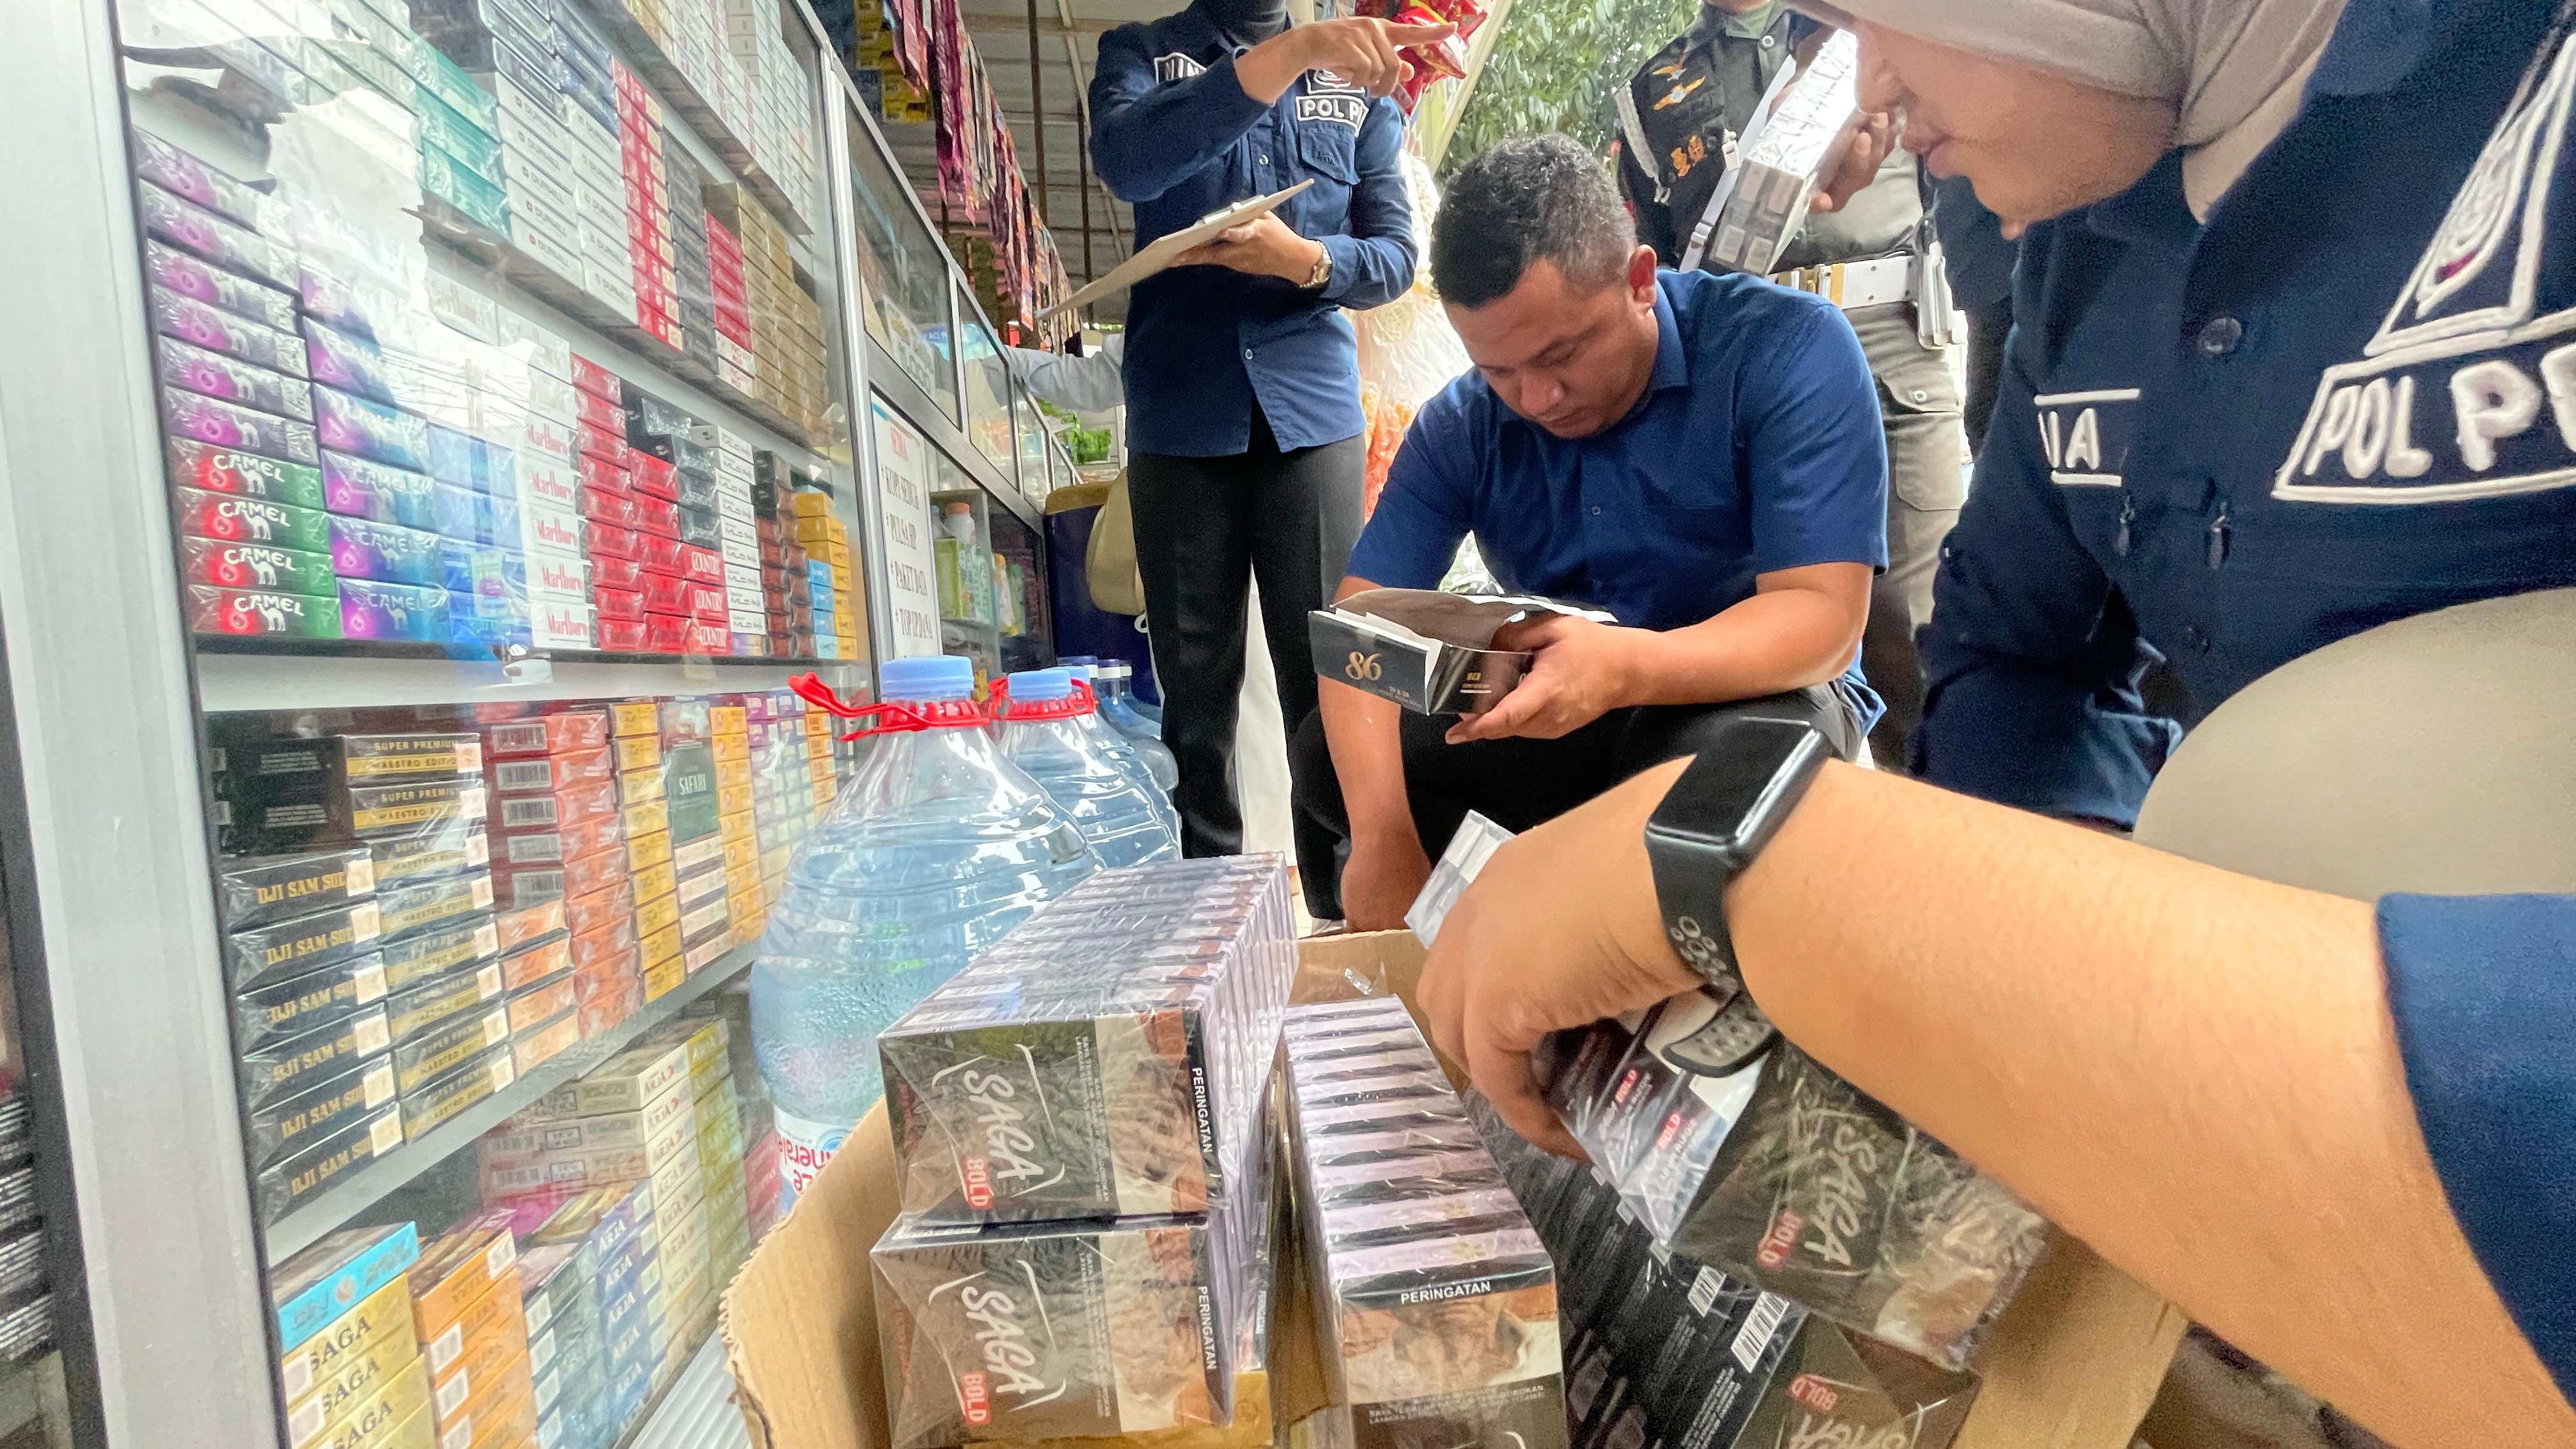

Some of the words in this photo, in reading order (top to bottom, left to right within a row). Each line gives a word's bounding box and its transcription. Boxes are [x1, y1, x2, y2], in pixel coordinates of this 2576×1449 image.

[1303, 100, 1344, 119] POL
[2304, 375, 2433, 479] POL
[213, 455, 285, 482] CAMEL
[532, 470, 574, 502] Marlboro
[218, 502, 291, 528] CAMEL
[537, 516, 578, 546] Marlboro
[224, 548, 296, 571] CAMEL
[542, 564, 583, 593] Marlboro
[234, 595, 305, 617] CAMEL
[547, 610, 588, 636] Marlboro
[1346, 651, 1382, 680] 86
[374, 741, 409, 751] SUPER
[425, 758, 457, 767] EDITIO
[381, 791, 415, 803] SUPER
[418, 787, 461, 799] PREMIU
[678, 773, 707, 795] SAFARI
[257, 884, 283, 904] DJI
[288, 877, 319, 897] SAM
[447, 898, 473, 912] EDITIO
[266, 943, 292, 965] DJI
[296, 934, 328, 956] SAM
[271, 1000, 297, 1023] DJI
[300, 988, 332, 1013] SAM
[303, 1043, 335, 1070] SAM
[643, 1071, 668, 1094] ARIA
[282, 1114, 307, 1139] DJI
[310, 1097, 341, 1124] SAM
[648, 1104, 671, 1130] ARIA
[963, 1069, 1044, 1180] SAGA
[1192, 1066, 1213, 1153] PERINGATAN
[291, 1169, 316, 1196] DJI
[319, 1150, 349, 1180] SAM
[965, 1158, 989, 1208] BOLD
[598, 1219, 627, 1256] ARIA
[1759, 1211, 1803, 1264] BOLD
[604, 1254, 633, 1292] ARIA
[1400, 1281, 1491, 1304] PERINGATAN
[608, 1291, 636, 1330] ARIA
[961, 1285, 1045, 1394] SAGA
[1197, 1285, 1217, 1370] PERINGATAN
[309, 1317, 372, 1373] SAGA
[612, 1325, 640, 1364] ARIA
[322, 1357, 381, 1415] SAGA
[963, 1373, 988, 1422] BOLD
[1790, 1376, 1839, 1411] BOLD
